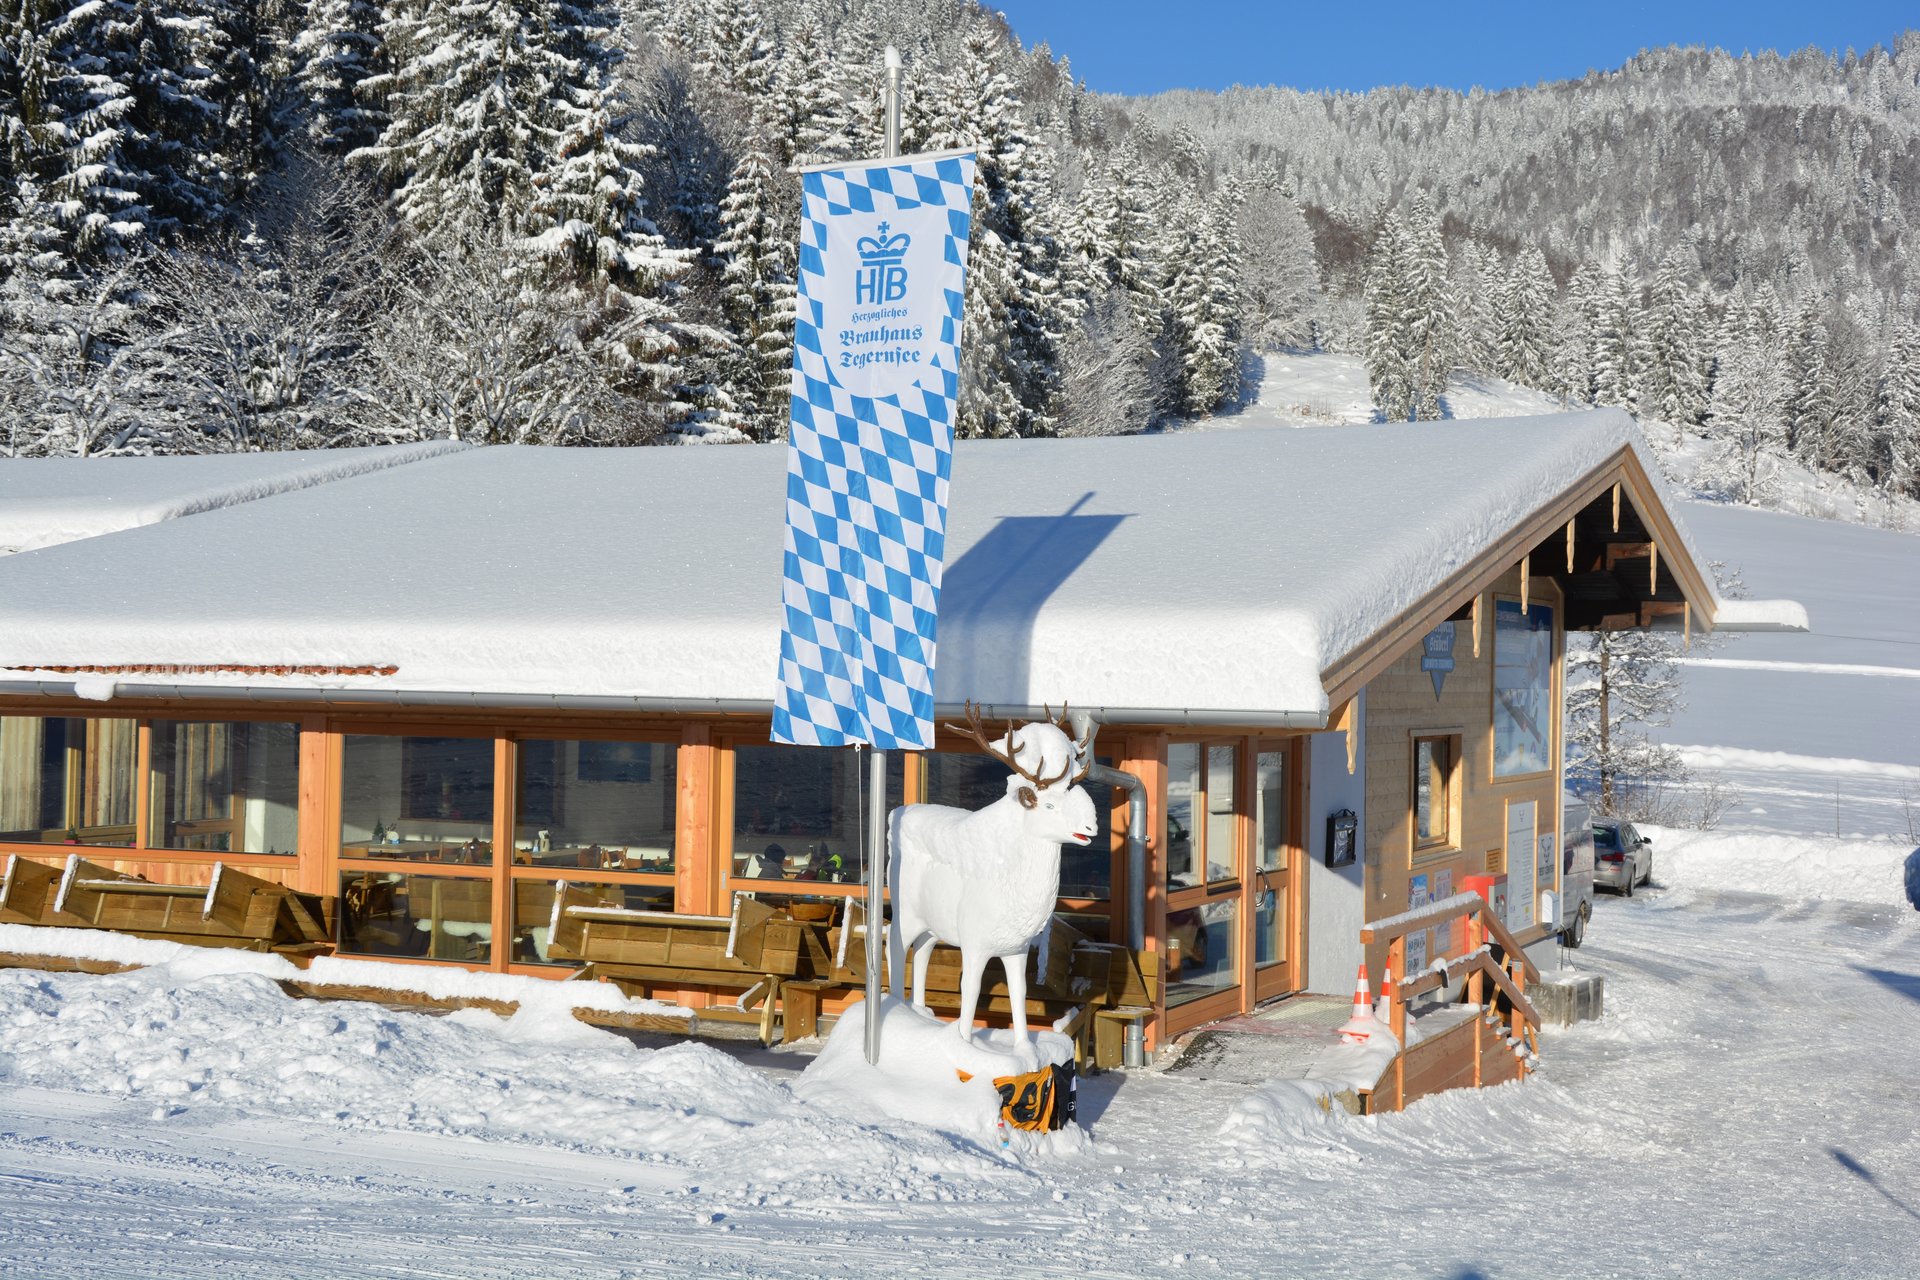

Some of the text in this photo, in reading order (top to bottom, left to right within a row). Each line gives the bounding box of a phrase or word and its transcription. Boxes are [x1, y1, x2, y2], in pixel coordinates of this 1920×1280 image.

[855, 258, 908, 306] HTB
[851, 307, 908, 324] Herzogliches
[839, 324, 923, 347] Brauhaus
[839, 346, 921, 369] Tegernsee
